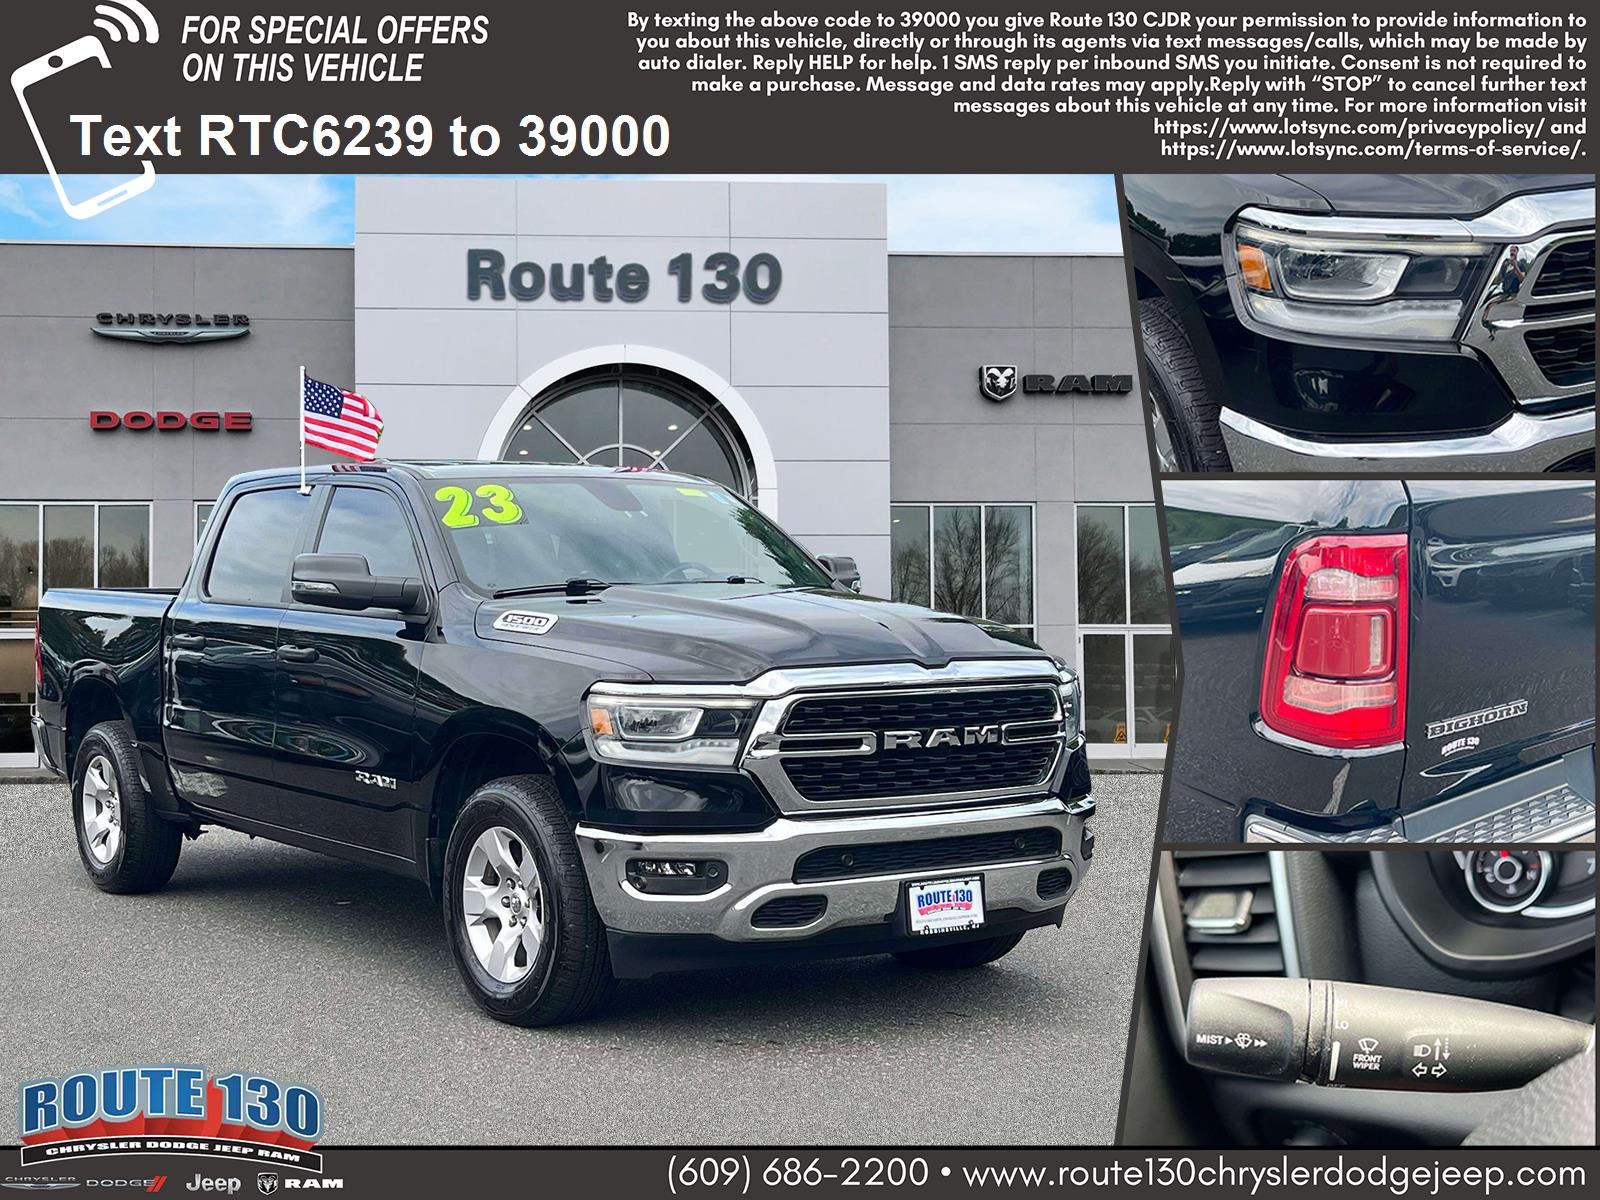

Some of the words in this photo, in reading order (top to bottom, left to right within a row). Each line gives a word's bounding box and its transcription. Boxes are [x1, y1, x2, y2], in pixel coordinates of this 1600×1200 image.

[467, 248, 650, 302] Route
[668, 252, 782, 304] 130
[96, 313, 250, 326] CHRYSLER
[1023, 374, 1133, 394] RAM
[89, 411, 253, 430] DODGE
[434, 485, 523, 528] 23
[505, 614, 549, 627] 1500
[884, 725, 999, 750] RAM
[917, 890, 952, 908] ROUTE
[954, 889, 973, 903] 130
[1335, 1020, 1349, 1030] LO
[1196, 1034, 1224, 1046] MIST
[1352, 1061, 1380, 1071] WIPER
[1353, 1053, 1382, 1063] FRONT
